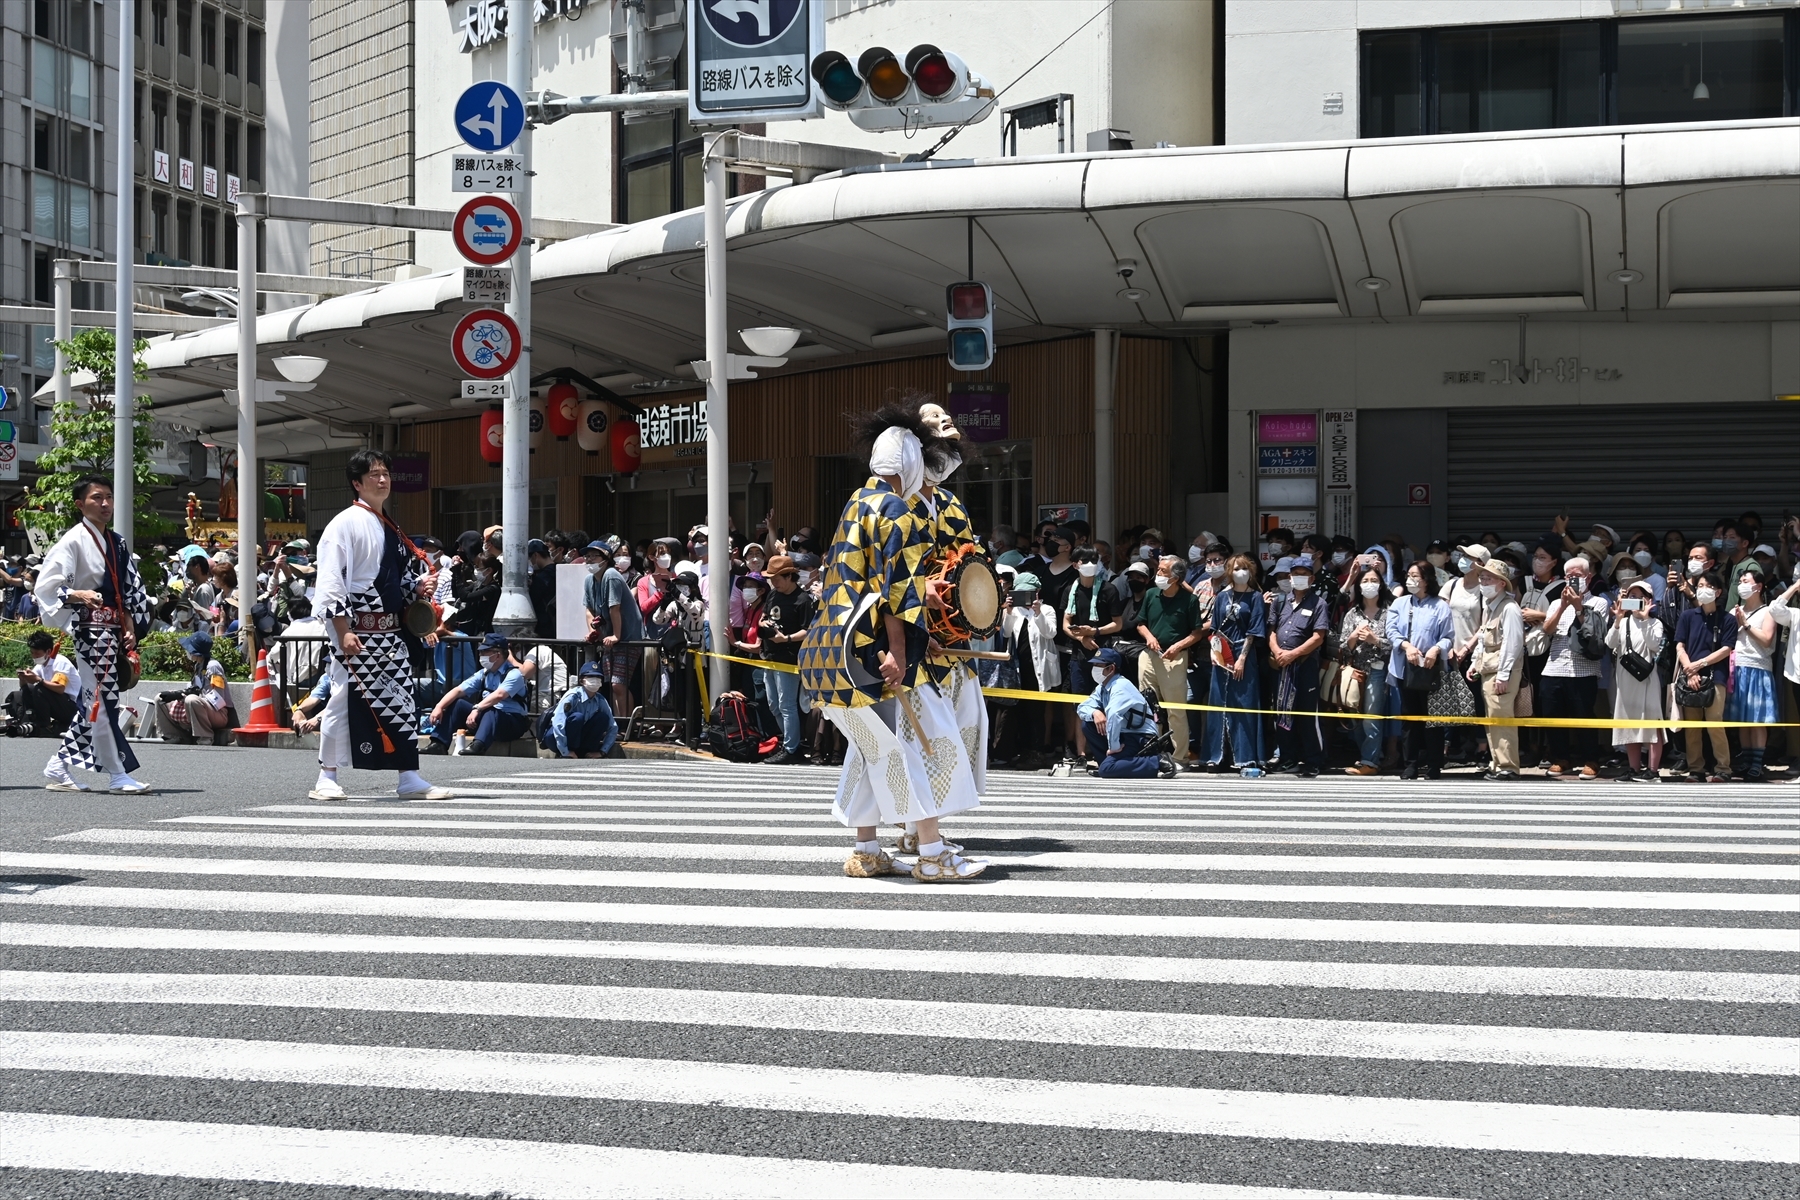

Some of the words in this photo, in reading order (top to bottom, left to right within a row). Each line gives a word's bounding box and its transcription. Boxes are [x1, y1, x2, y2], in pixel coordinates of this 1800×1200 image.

[702, 65, 804, 92] 路線バスを除く
[455, 158, 522, 172] 路線バスを除く
[466, 280, 510, 290] マイクロを除く
[957, 413, 1001, 427] 眼鏡市場
[1325, 412, 1342, 423] OPEN
[1343, 411, 1354, 419] 24
[1261, 449, 1281, 457] AGA
[1293, 449, 1315, 457] スキン
[1271, 458, 1305, 466] クリニック
